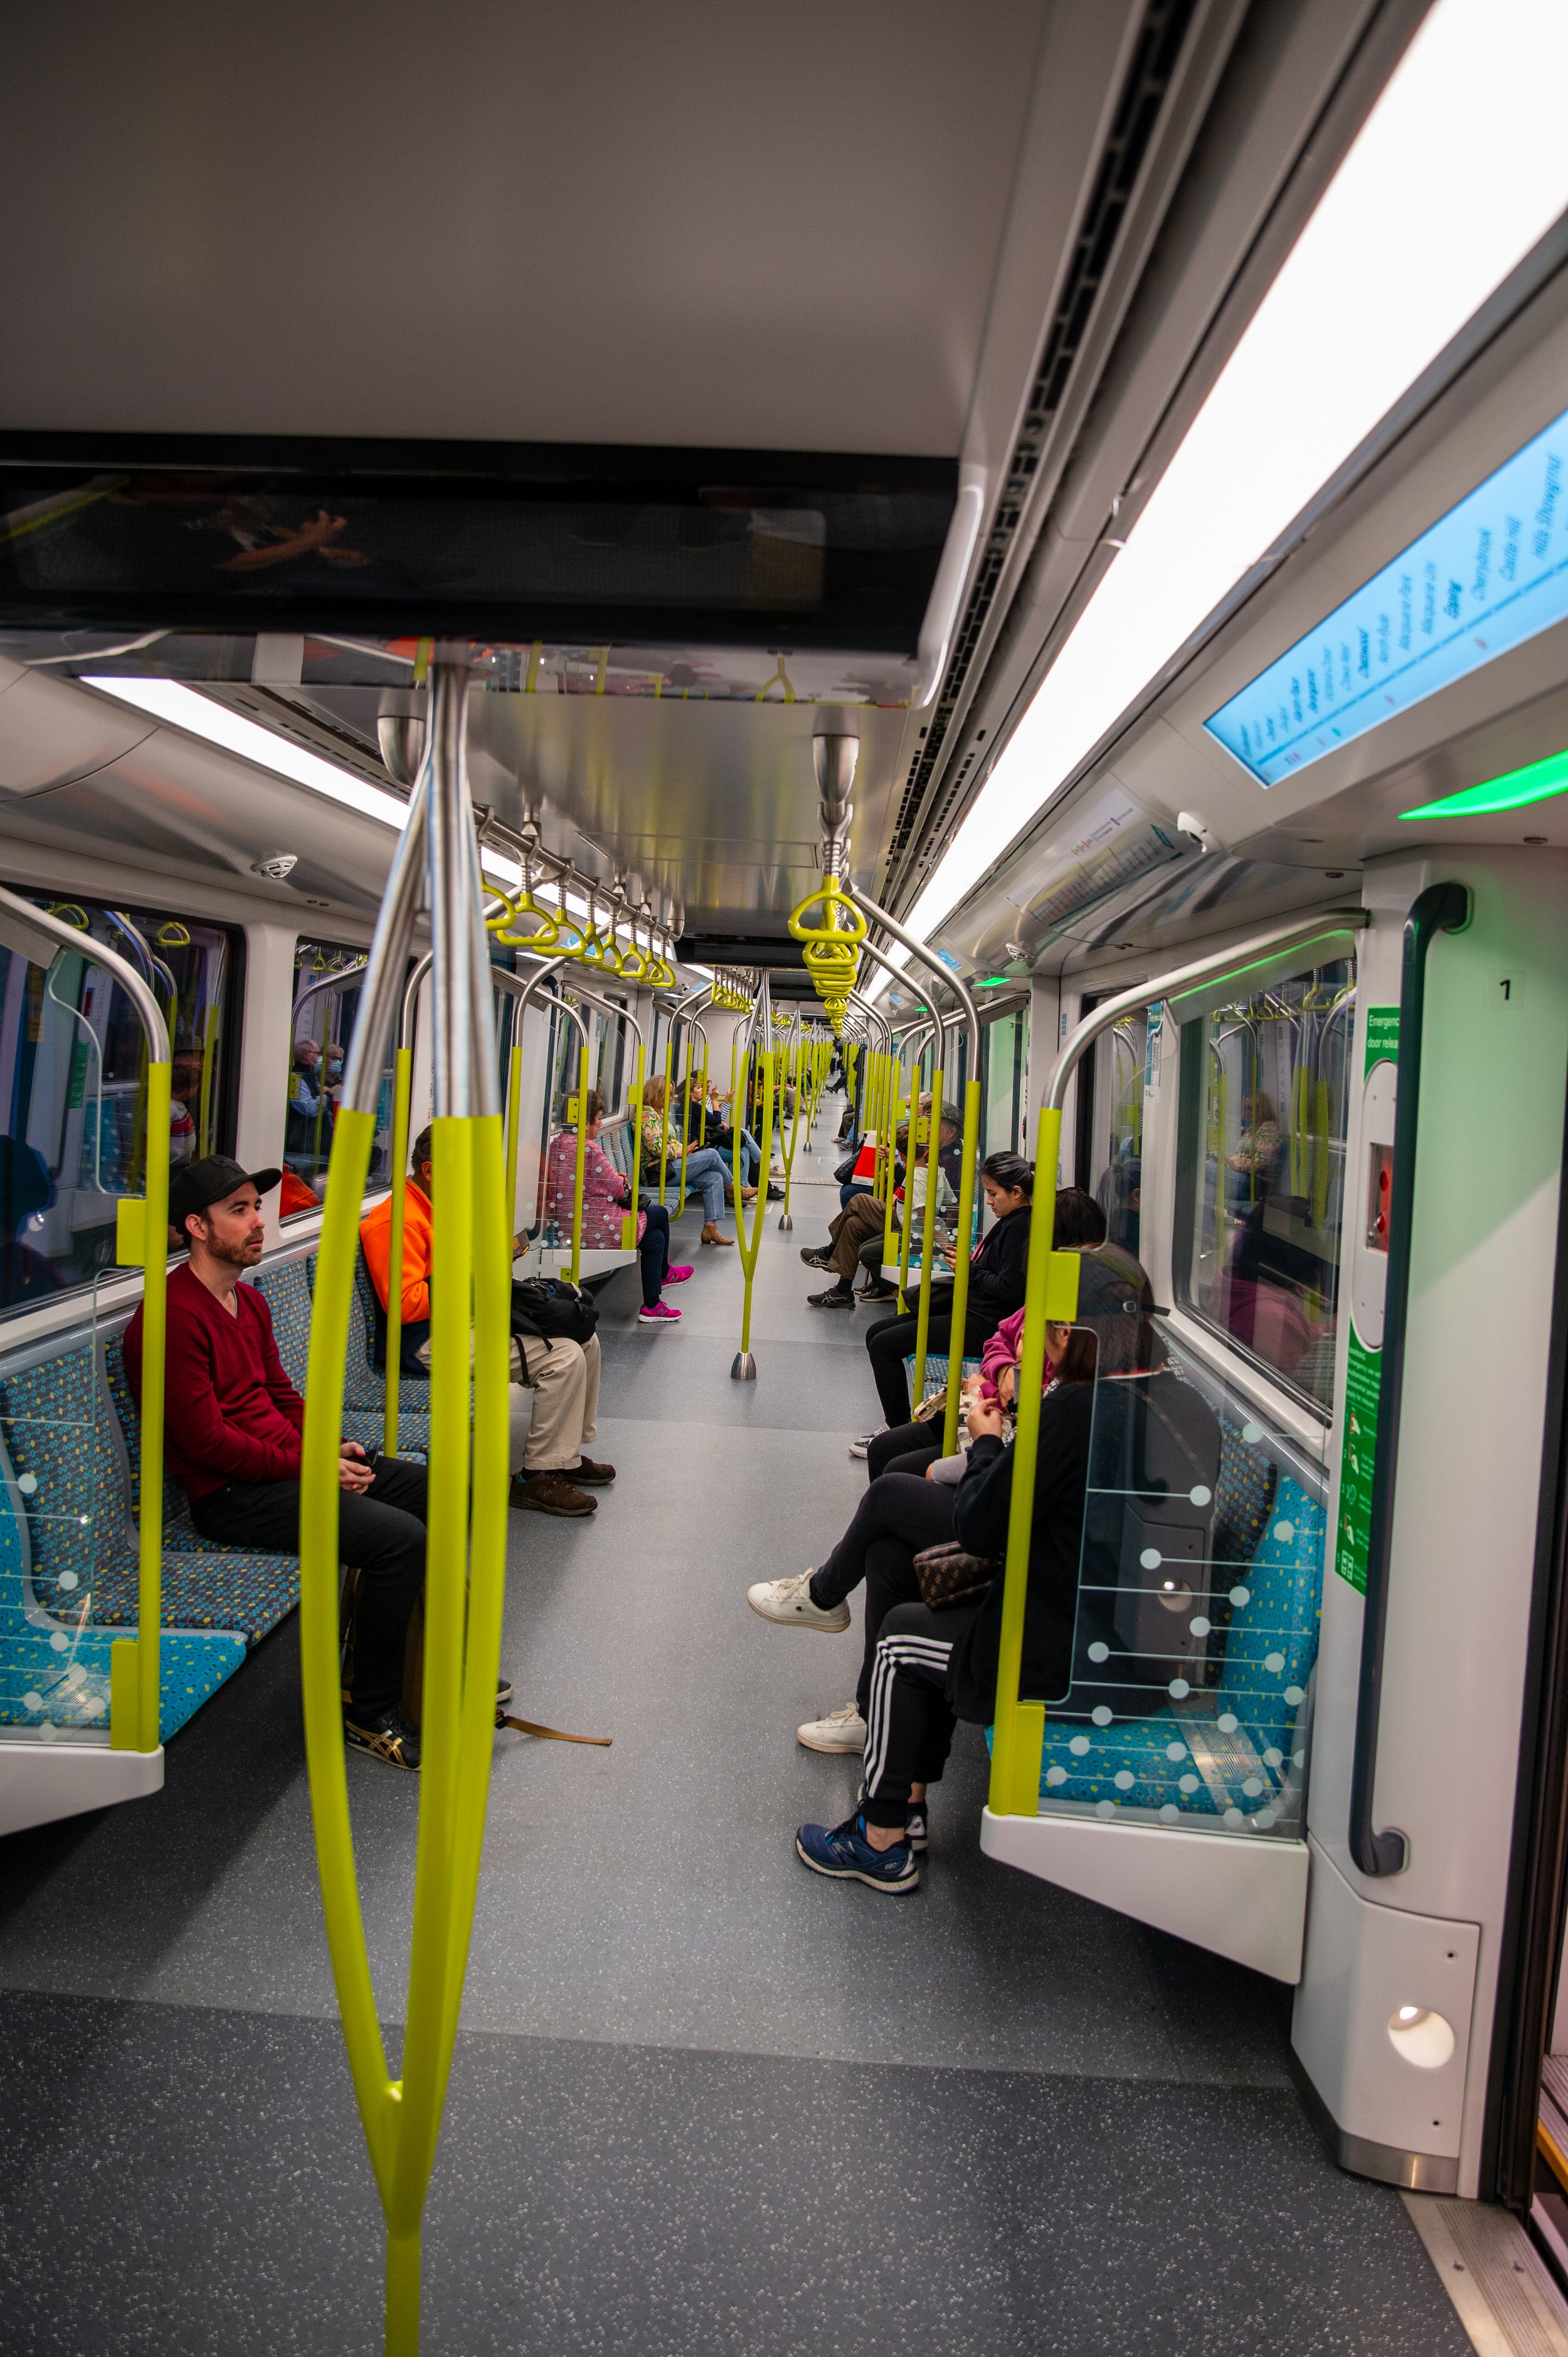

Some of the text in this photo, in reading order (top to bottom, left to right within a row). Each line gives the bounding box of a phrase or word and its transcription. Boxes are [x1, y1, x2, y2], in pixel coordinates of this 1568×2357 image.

[1498, 514, 1521, 581] Castle Hill
[1470, 526, 1492, 601] Cherrybrook
[1444, 579, 1462, 619] Epping
[1500, 979, 1510, 1001] 1
[1369, 1014, 1400, 1030] Emergenc
[1367, 1036, 1399, 1049] door relea
[1343, 1449, 1347, 1458] 2
